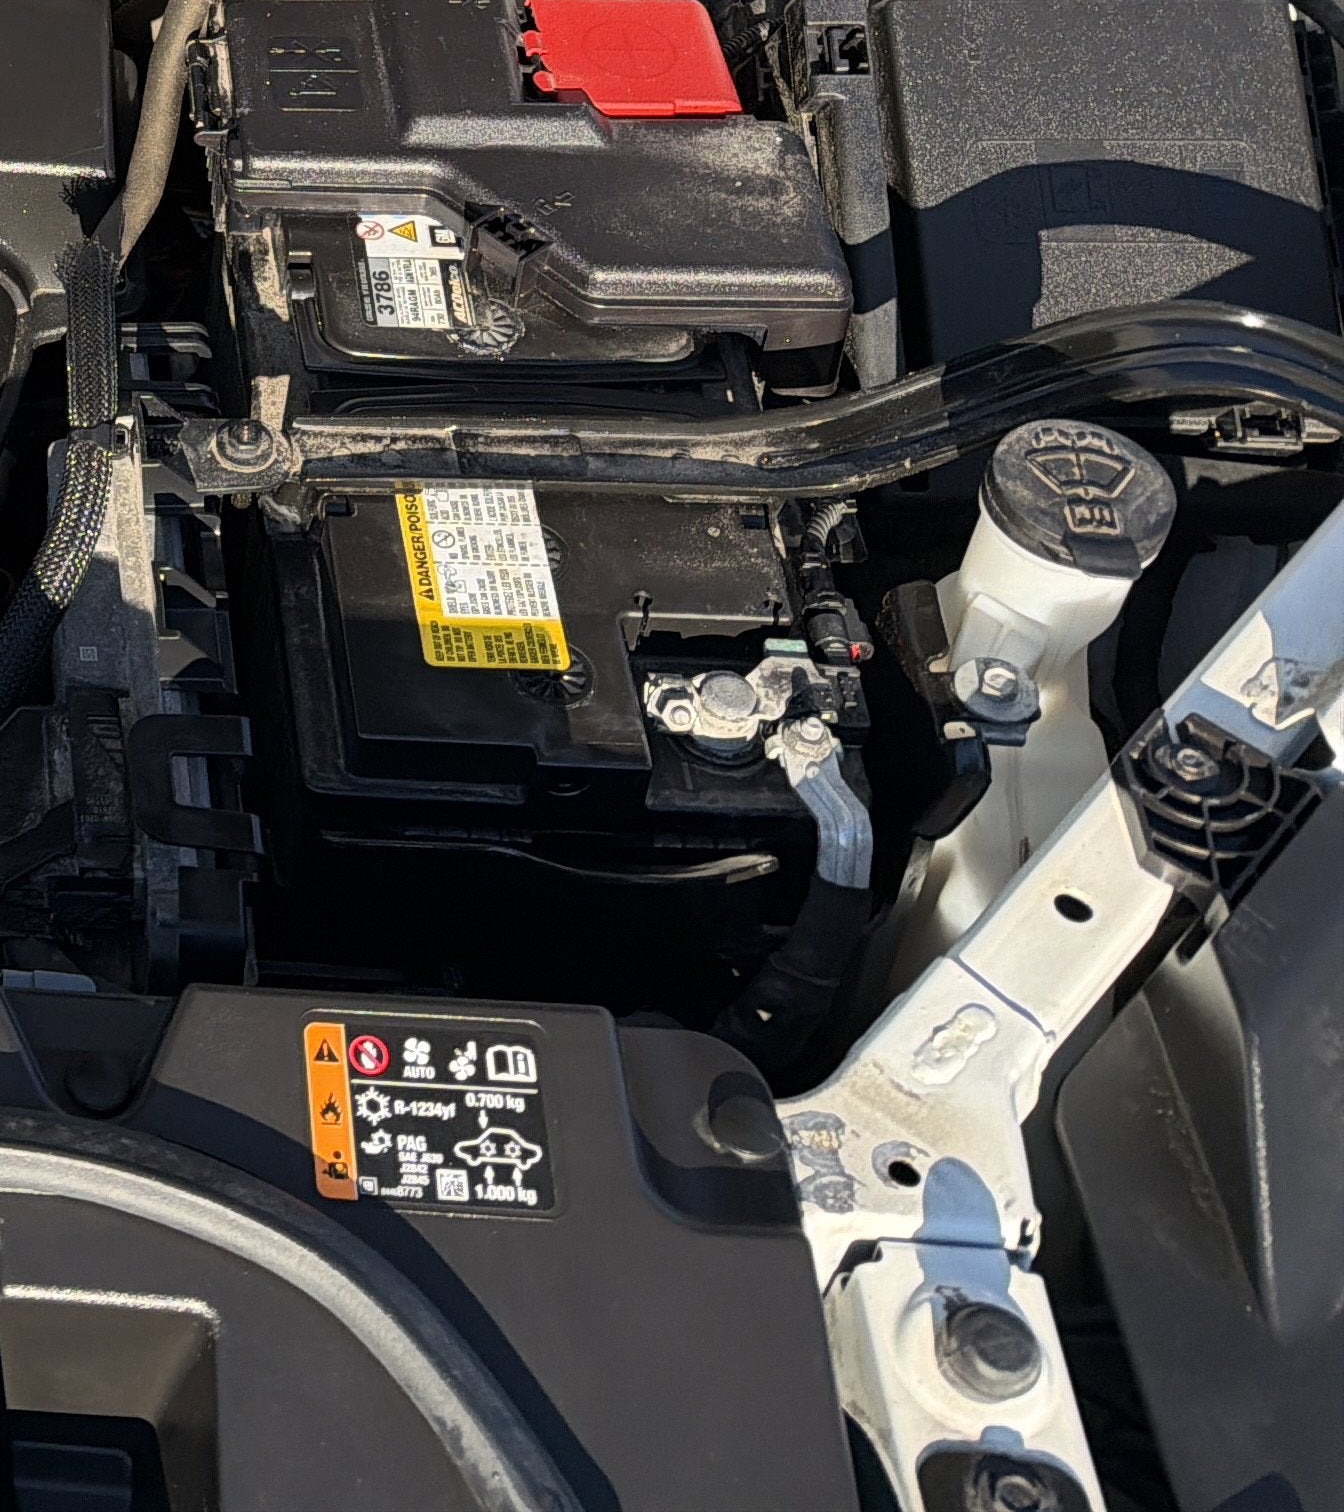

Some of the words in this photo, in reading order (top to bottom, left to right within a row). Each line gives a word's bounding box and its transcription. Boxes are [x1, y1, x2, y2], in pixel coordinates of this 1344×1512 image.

[372, 270, 395, 316] 3786
[448, 264, 469, 324] ACDelco
[408, 289, 422, 322] 94RAGM
[405, 492, 434, 586] DANGER/POISO
[403, 1065, 436, 1080] AUTO
[393, 1100, 457, 1121] R-1234yf
[465, 1092, 504, 1109] 0.700
[506, 1094, 526, 1114] kg
[396, 1134, 428, 1152] PAG
[474, 1183, 516, 1201] 1.000
[517, 1186, 538, 1207] kg
